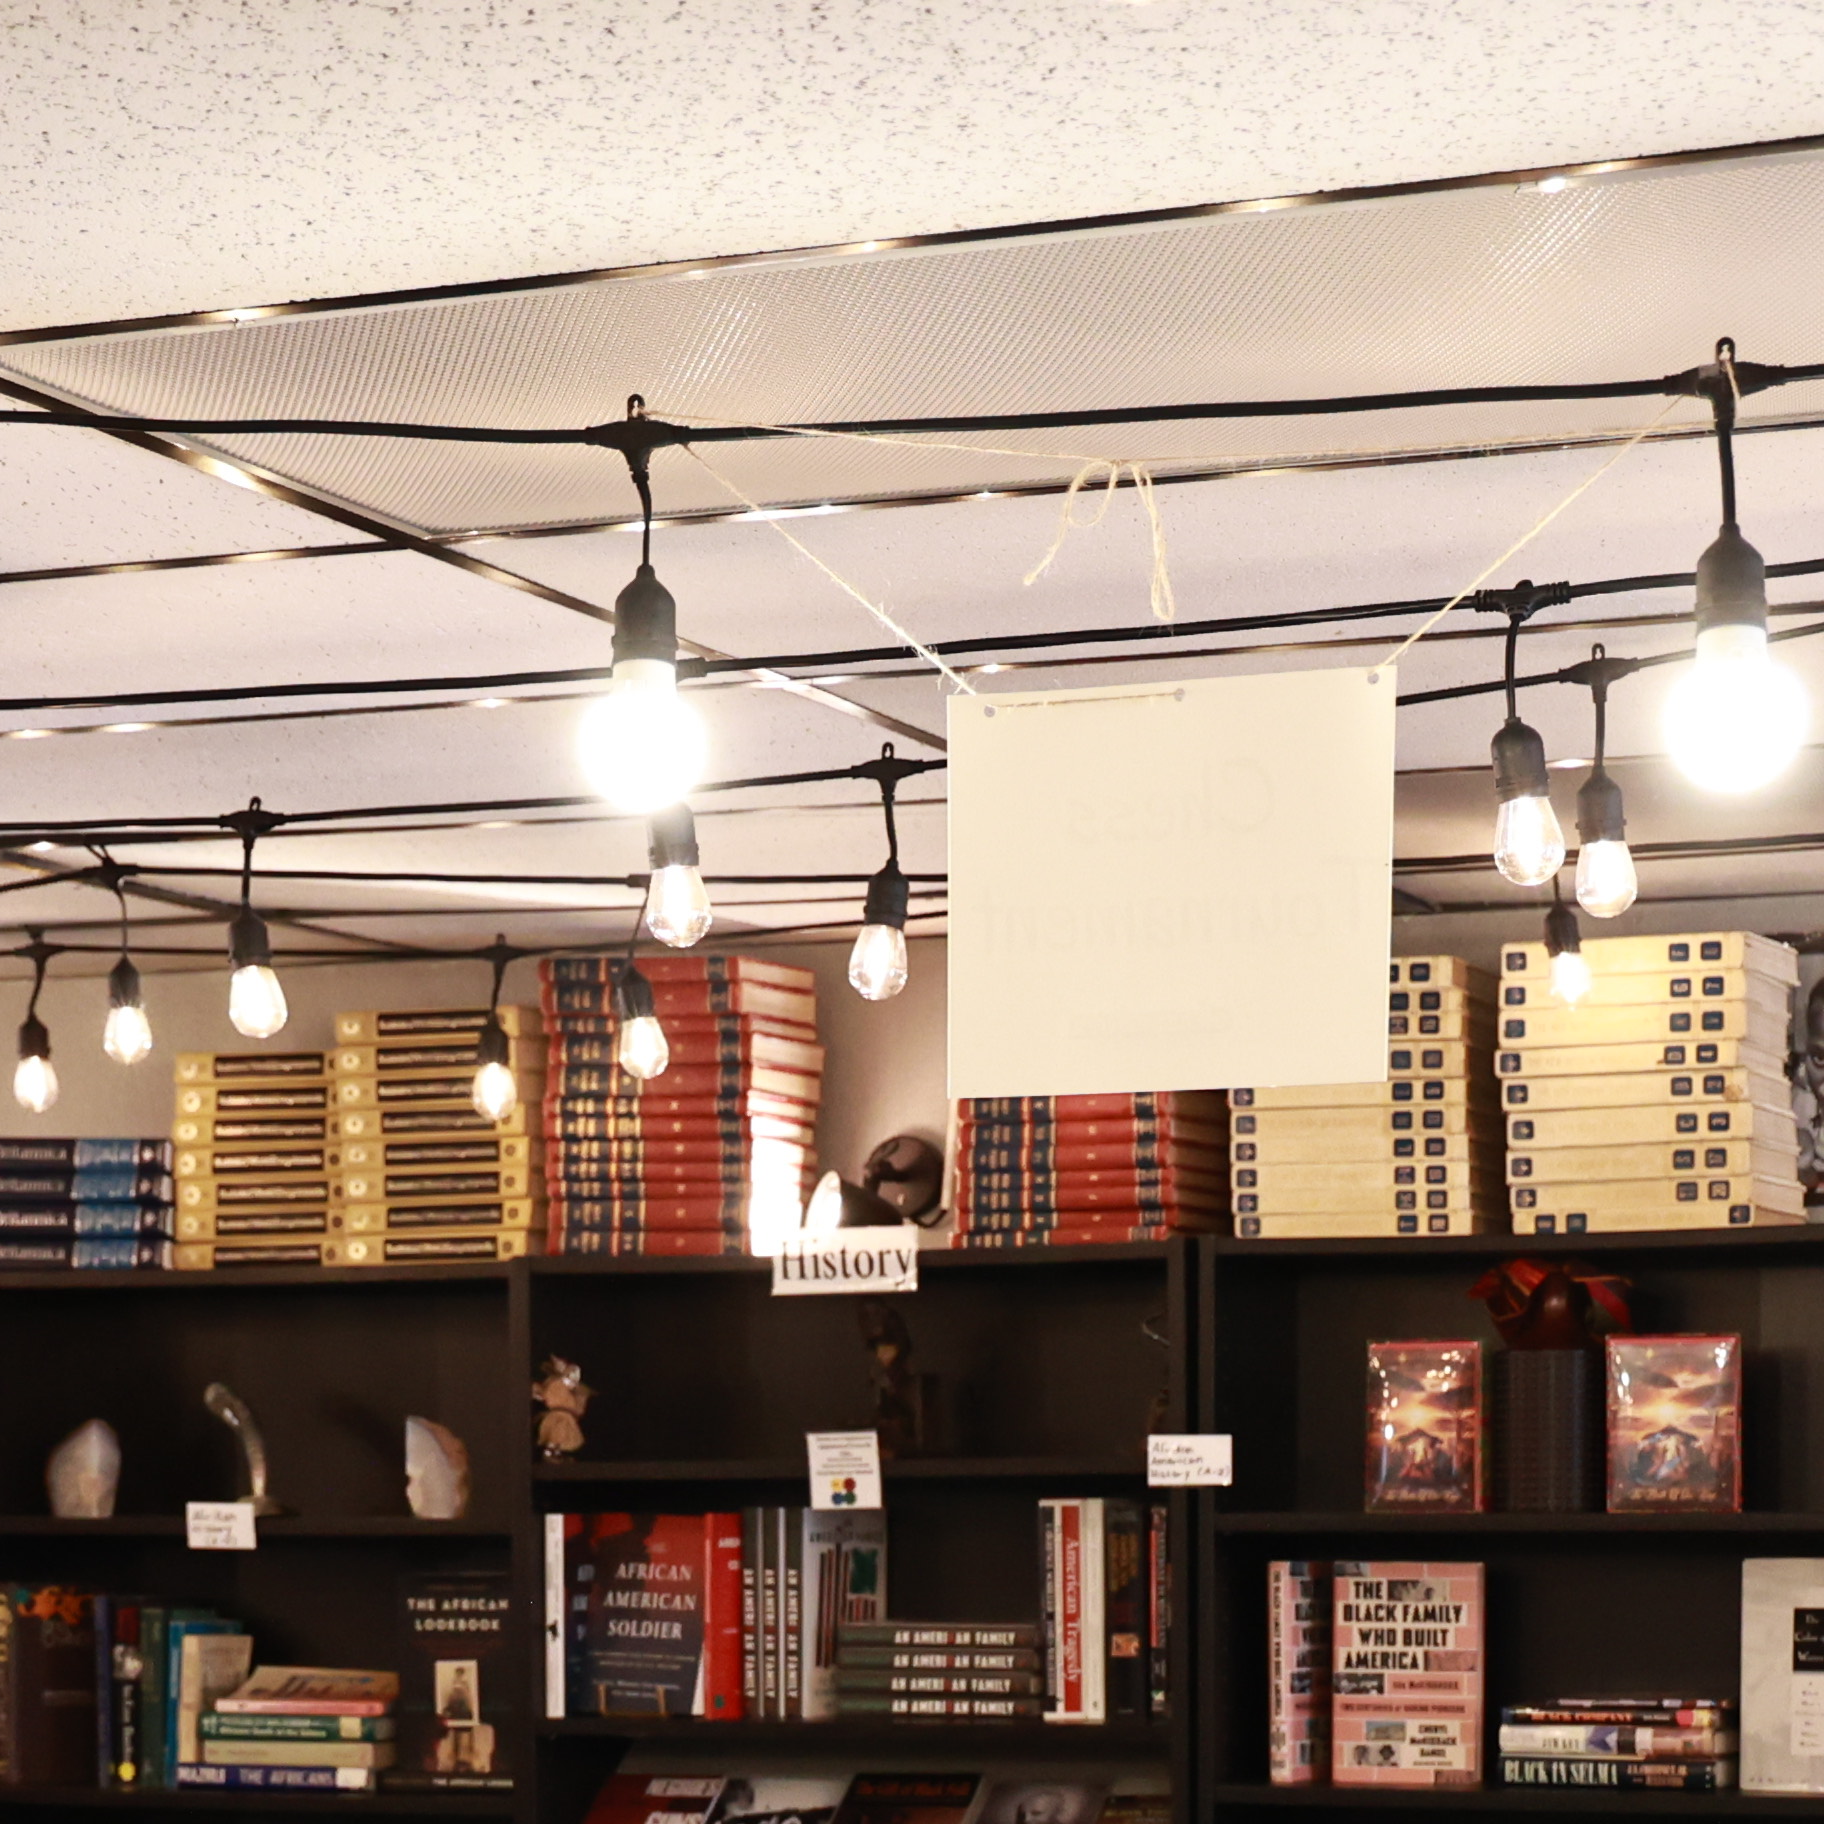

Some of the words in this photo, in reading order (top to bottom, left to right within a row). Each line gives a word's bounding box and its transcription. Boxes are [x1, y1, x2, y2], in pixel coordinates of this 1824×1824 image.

[781, 1239, 912, 1287] History
[615, 1562, 693, 1582] AFRICAN
[1065, 1537, 1081, 1614] American
[1353, 1581, 1382, 1599] THE
[407, 1598, 435, 1611] THE
[441, 1598, 509, 1612] AFRICAN
[603, 1591, 697, 1611] AMERICAN
[1343, 1603, 1396, 1622] BLACK
[1403, 1604, 1463, 1623] FAMILY
[415, 1618, 501, 1632] LOOKBOOK
[607, 1619, 682, 1640] SOLDIER
[976, 1632, 1016, 1647] FAMILY
[1359, 1628, 1397, 1646] WHO
[1403, 1628, 1449, 1647] BUILT
[1063, 1618, 1081, 1683] Tragedy
[975, 1655, 1015, 1670] FAMILY
[1344, 1651, 1420, 1670] AMERICA
[972, 1678, 1012, 1693] FAMILY
[974, 1700, 1014, 1715] FAMILY
[238, 1767, 263, 1784] THE
[269, 1767, 333, 1786] AFRICANS
[1505, 1760, 1548, 1783] BLACK
[1552, 1761, 1567, 1783] IN
[1570, 1762, 1618, 1785] SELMA
